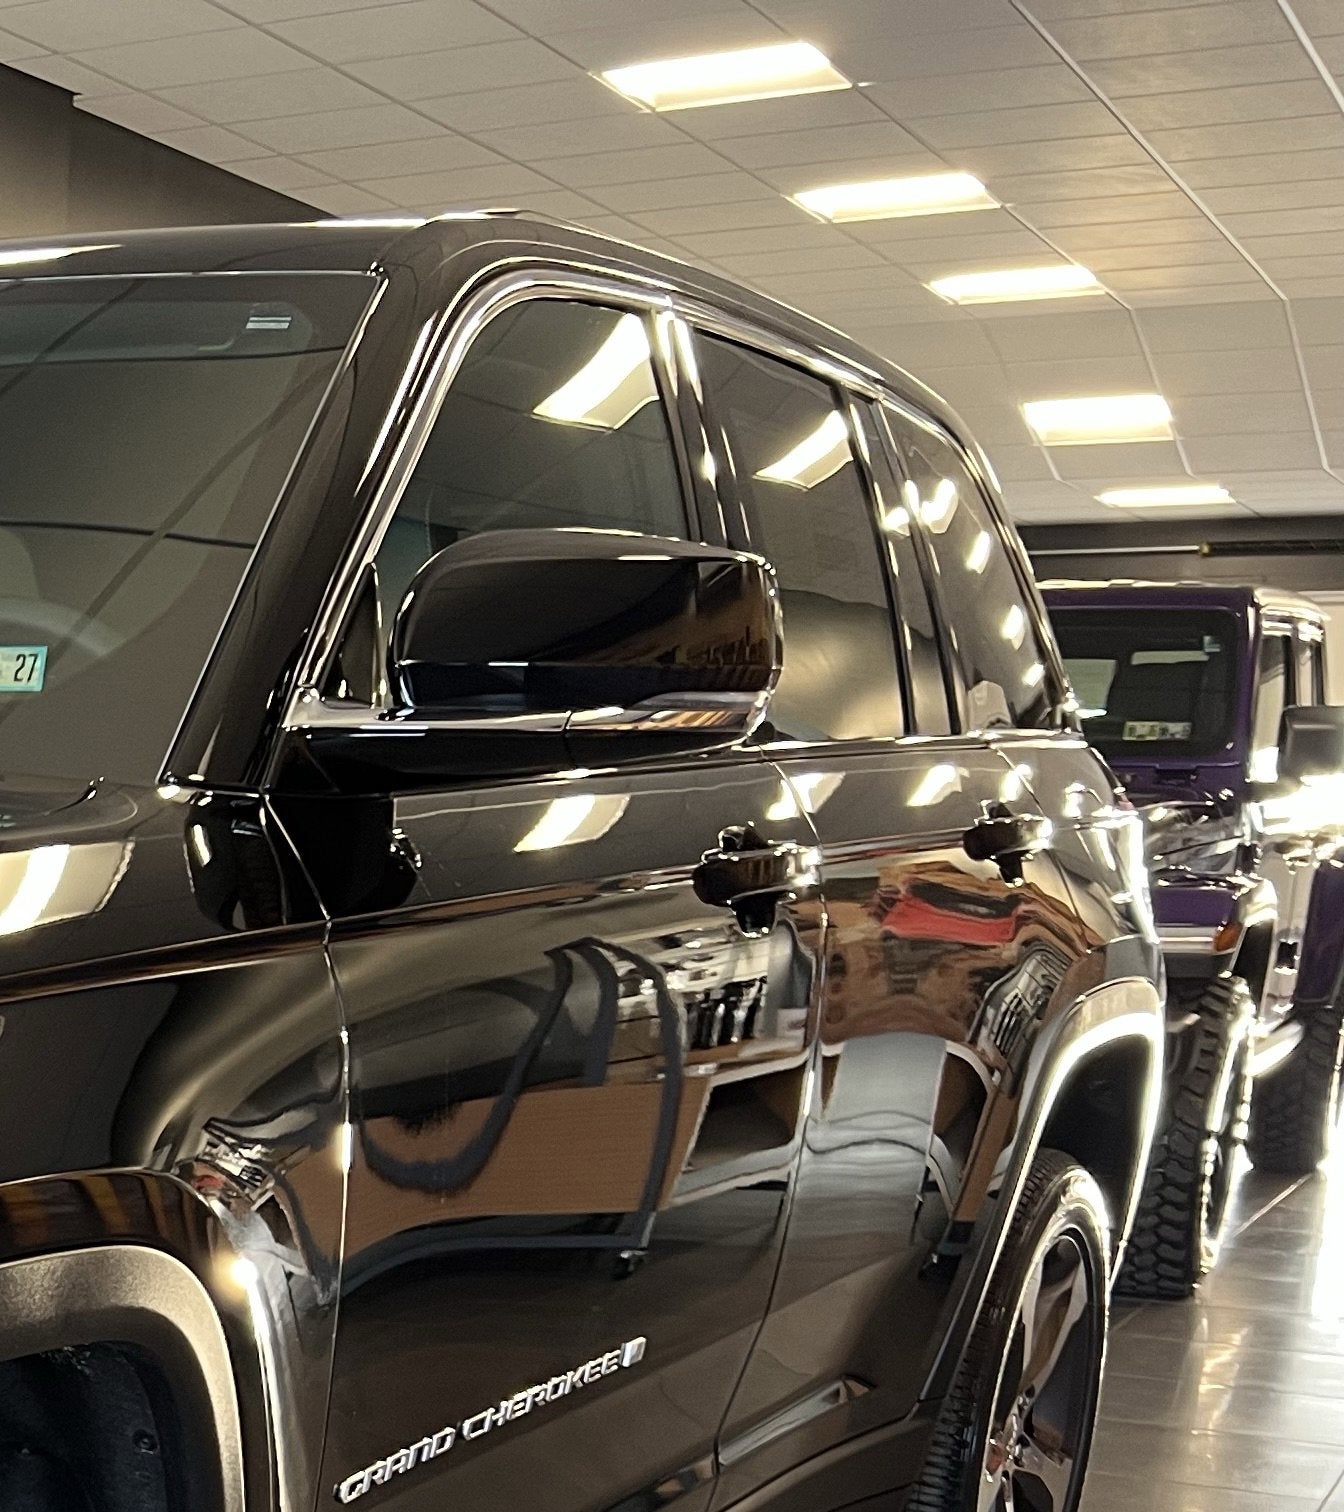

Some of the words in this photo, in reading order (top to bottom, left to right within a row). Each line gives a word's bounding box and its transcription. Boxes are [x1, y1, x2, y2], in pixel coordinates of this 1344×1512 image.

[13, 653, 38, 683] 27
[338, 1425, 457, 1504] GRAND
[461, 1349, 622, 1441] CHEROKEE
